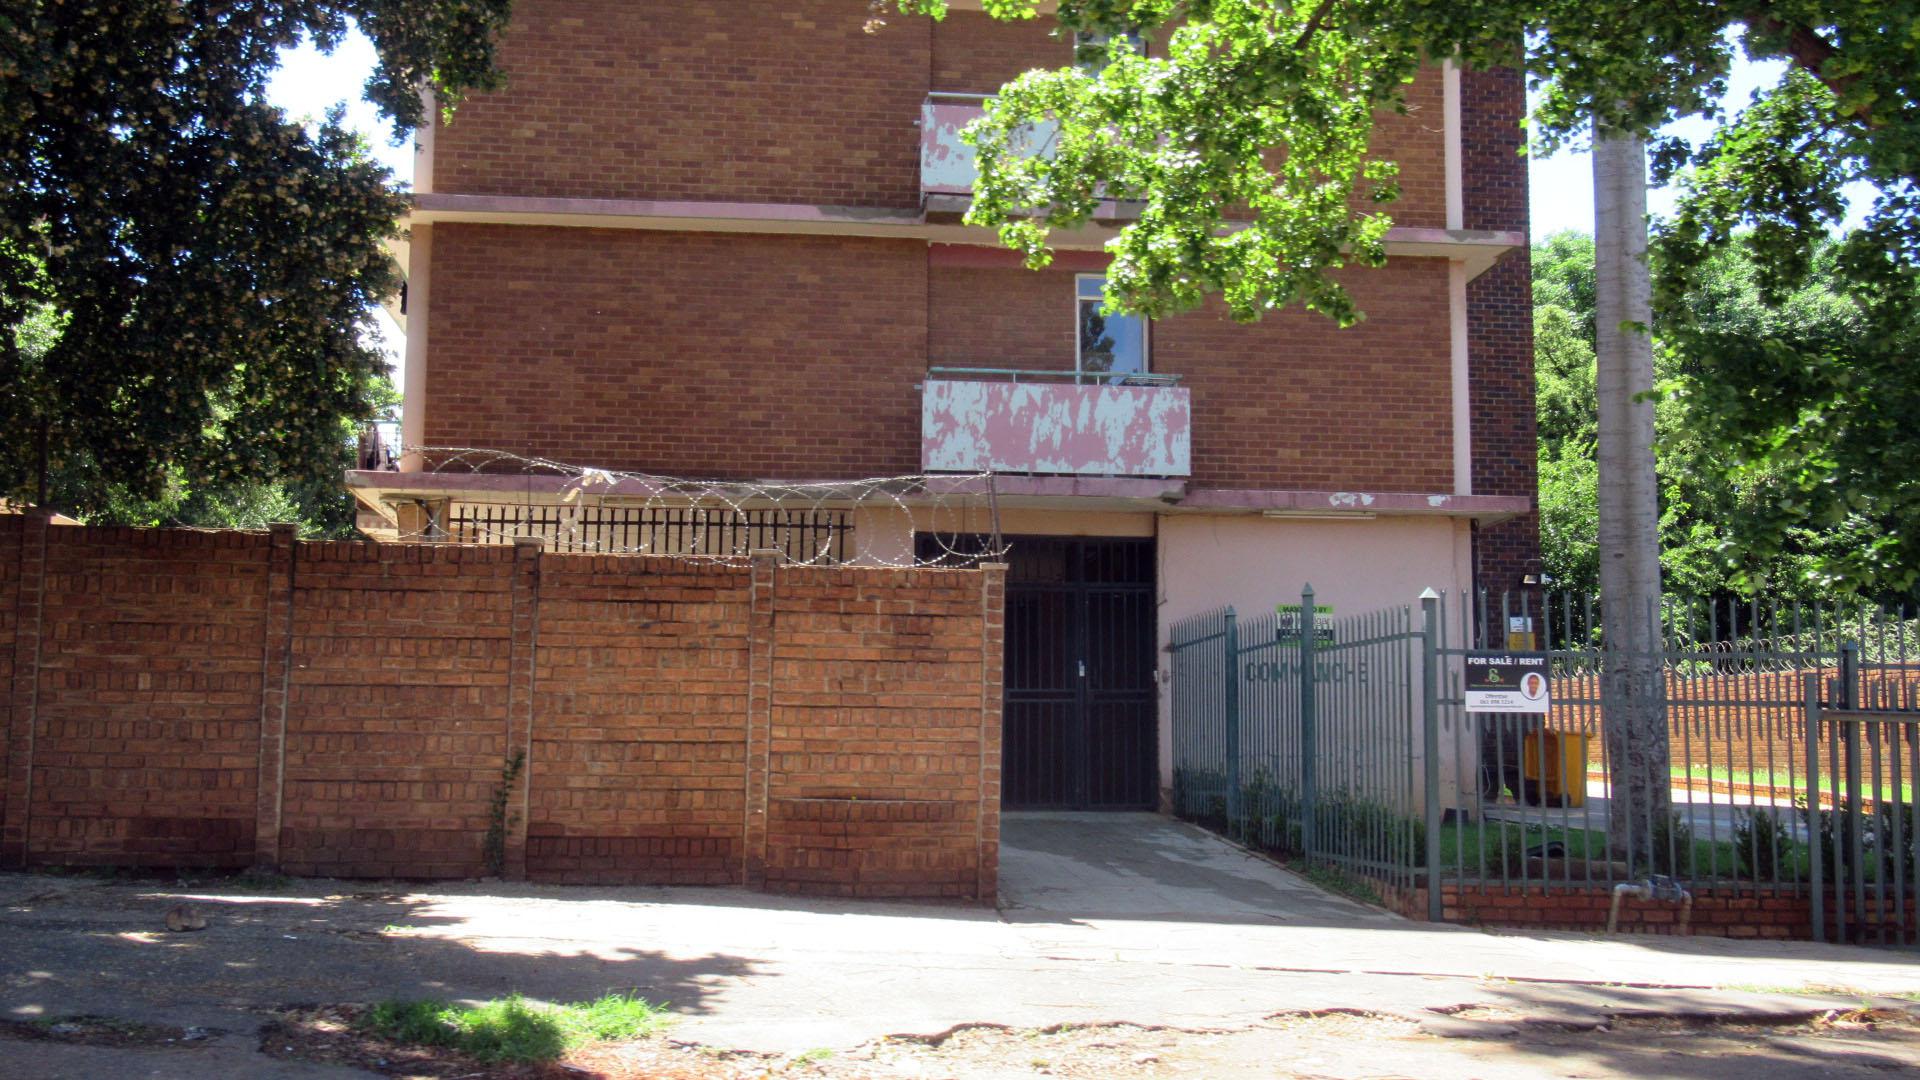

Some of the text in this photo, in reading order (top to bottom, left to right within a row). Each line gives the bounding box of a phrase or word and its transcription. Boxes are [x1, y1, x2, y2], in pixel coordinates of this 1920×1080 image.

[1468, 657, 1487, 665] FOR
[1489, 657, 1512, 665] SALE
[1519, 657, 1544, 665] RENT
[1246, 662, 1368, 683] COMMNCHE
